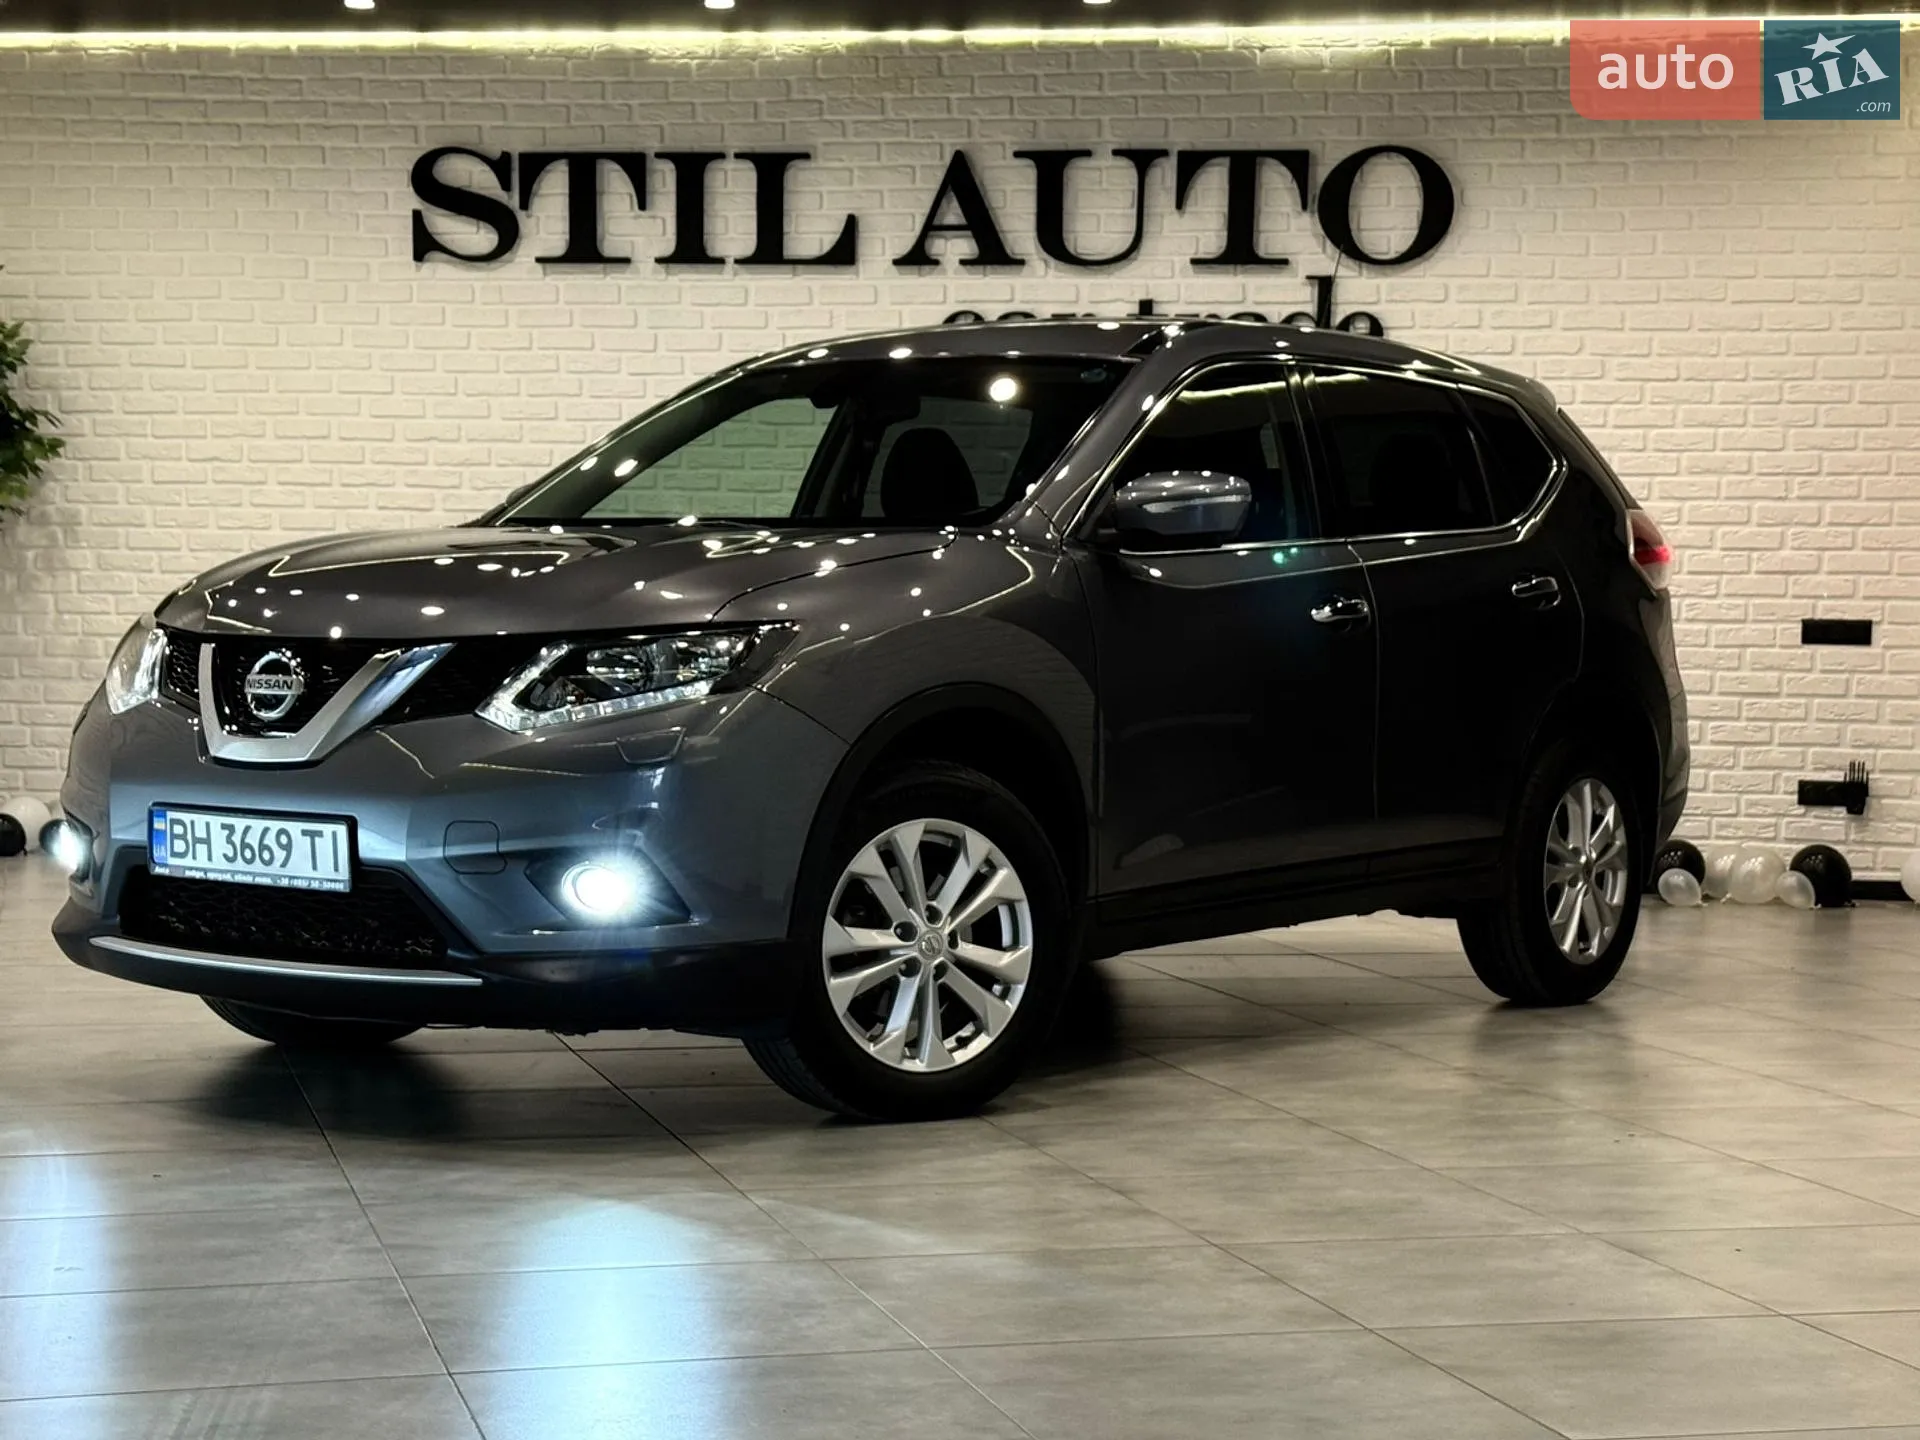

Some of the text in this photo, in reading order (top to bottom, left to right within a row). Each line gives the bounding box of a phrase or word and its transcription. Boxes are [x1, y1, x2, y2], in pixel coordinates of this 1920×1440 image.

[410, 144, 1455, 268] STIL AUTO
[246, 678, 294, 690] NISSAN
[169, 817, 340, 873] BH 3669 TI
